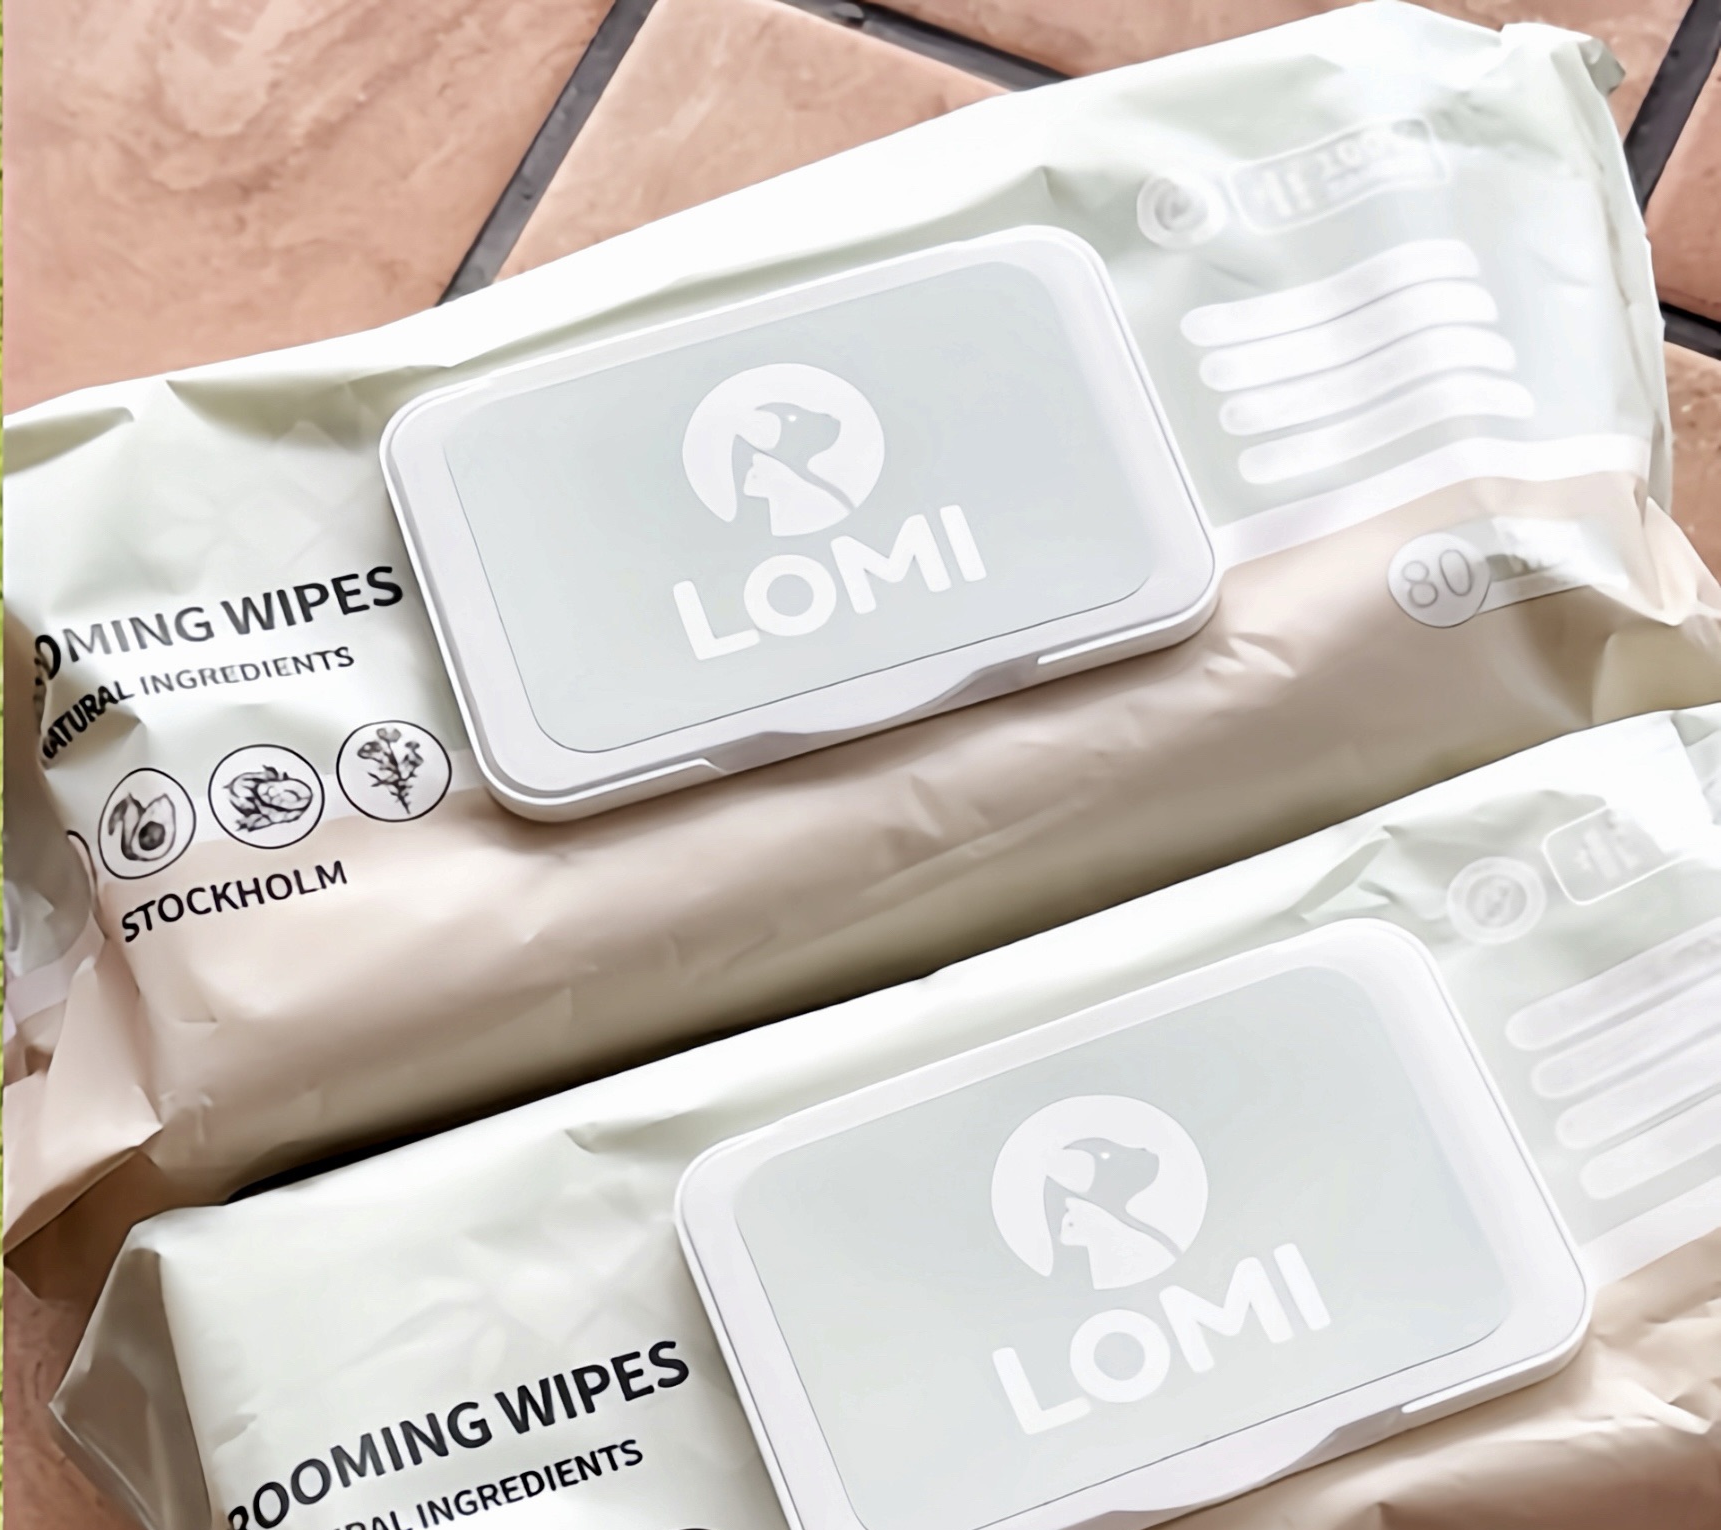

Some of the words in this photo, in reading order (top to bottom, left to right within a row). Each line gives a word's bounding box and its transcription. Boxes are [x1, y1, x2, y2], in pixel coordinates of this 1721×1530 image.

[673, 504, 987, 660] LOMI
[1401, 549, 1474, 608] 80
[35, 605, 215, 682] OMING
[220, 566, 403, 635] WIPES
[140, 646, 354, 696] INGREDIENTS
[121, 860, 347, 943] STOCKHOLM
[992, 1243, 1331, 1435] LOMI
[494, 1341, 689, 1435] WIPES
[417, 1439, 643, 1526] INGREDIENTS
